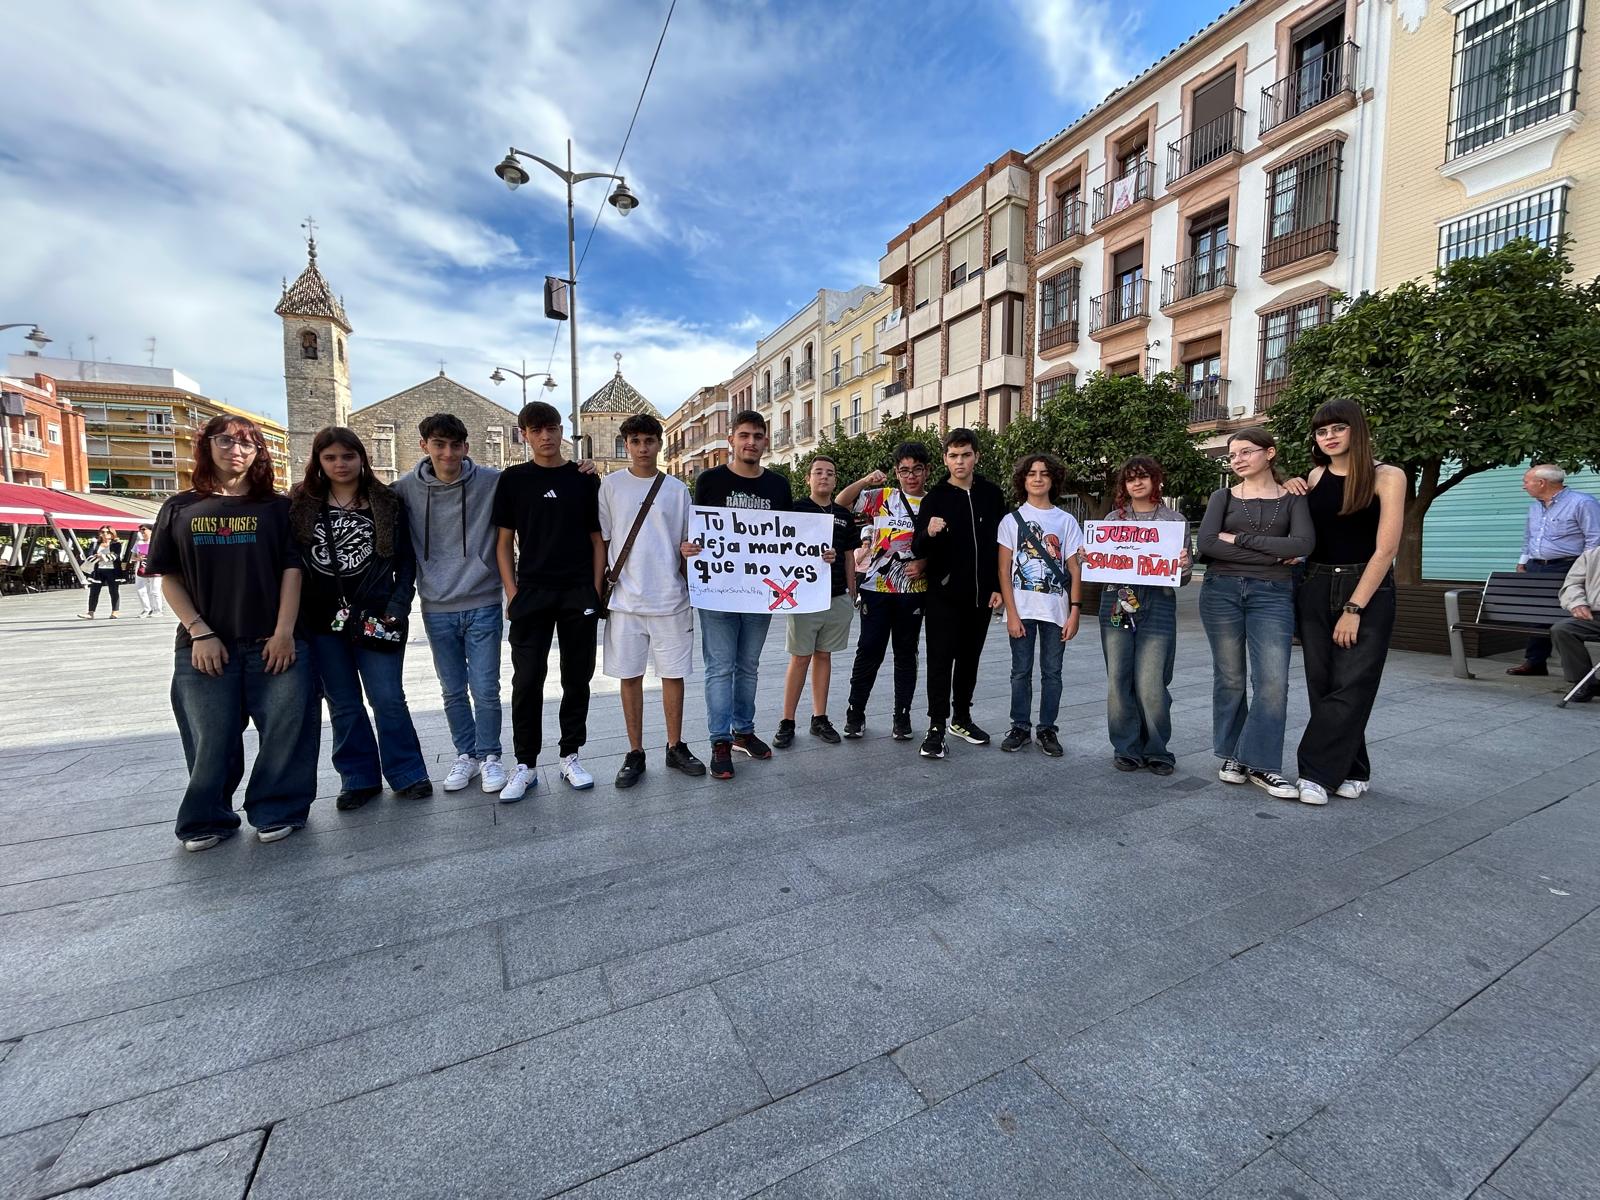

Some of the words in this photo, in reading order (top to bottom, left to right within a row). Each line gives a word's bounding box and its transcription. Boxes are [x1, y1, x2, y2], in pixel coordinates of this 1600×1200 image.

[726, 496, 771, 510] RAMONES
[191, 516, 217, 532] GUNS
[229, 516, 258, 532] ROSES
[695, 511, 724, 531] Tu
[732, 512, 796, 538] burla
[693, 533, 740, 559] deja
[694, 559, 735, 584] que
[744, 562, 771, 576] no
[779, 564, 818, 583] ves
